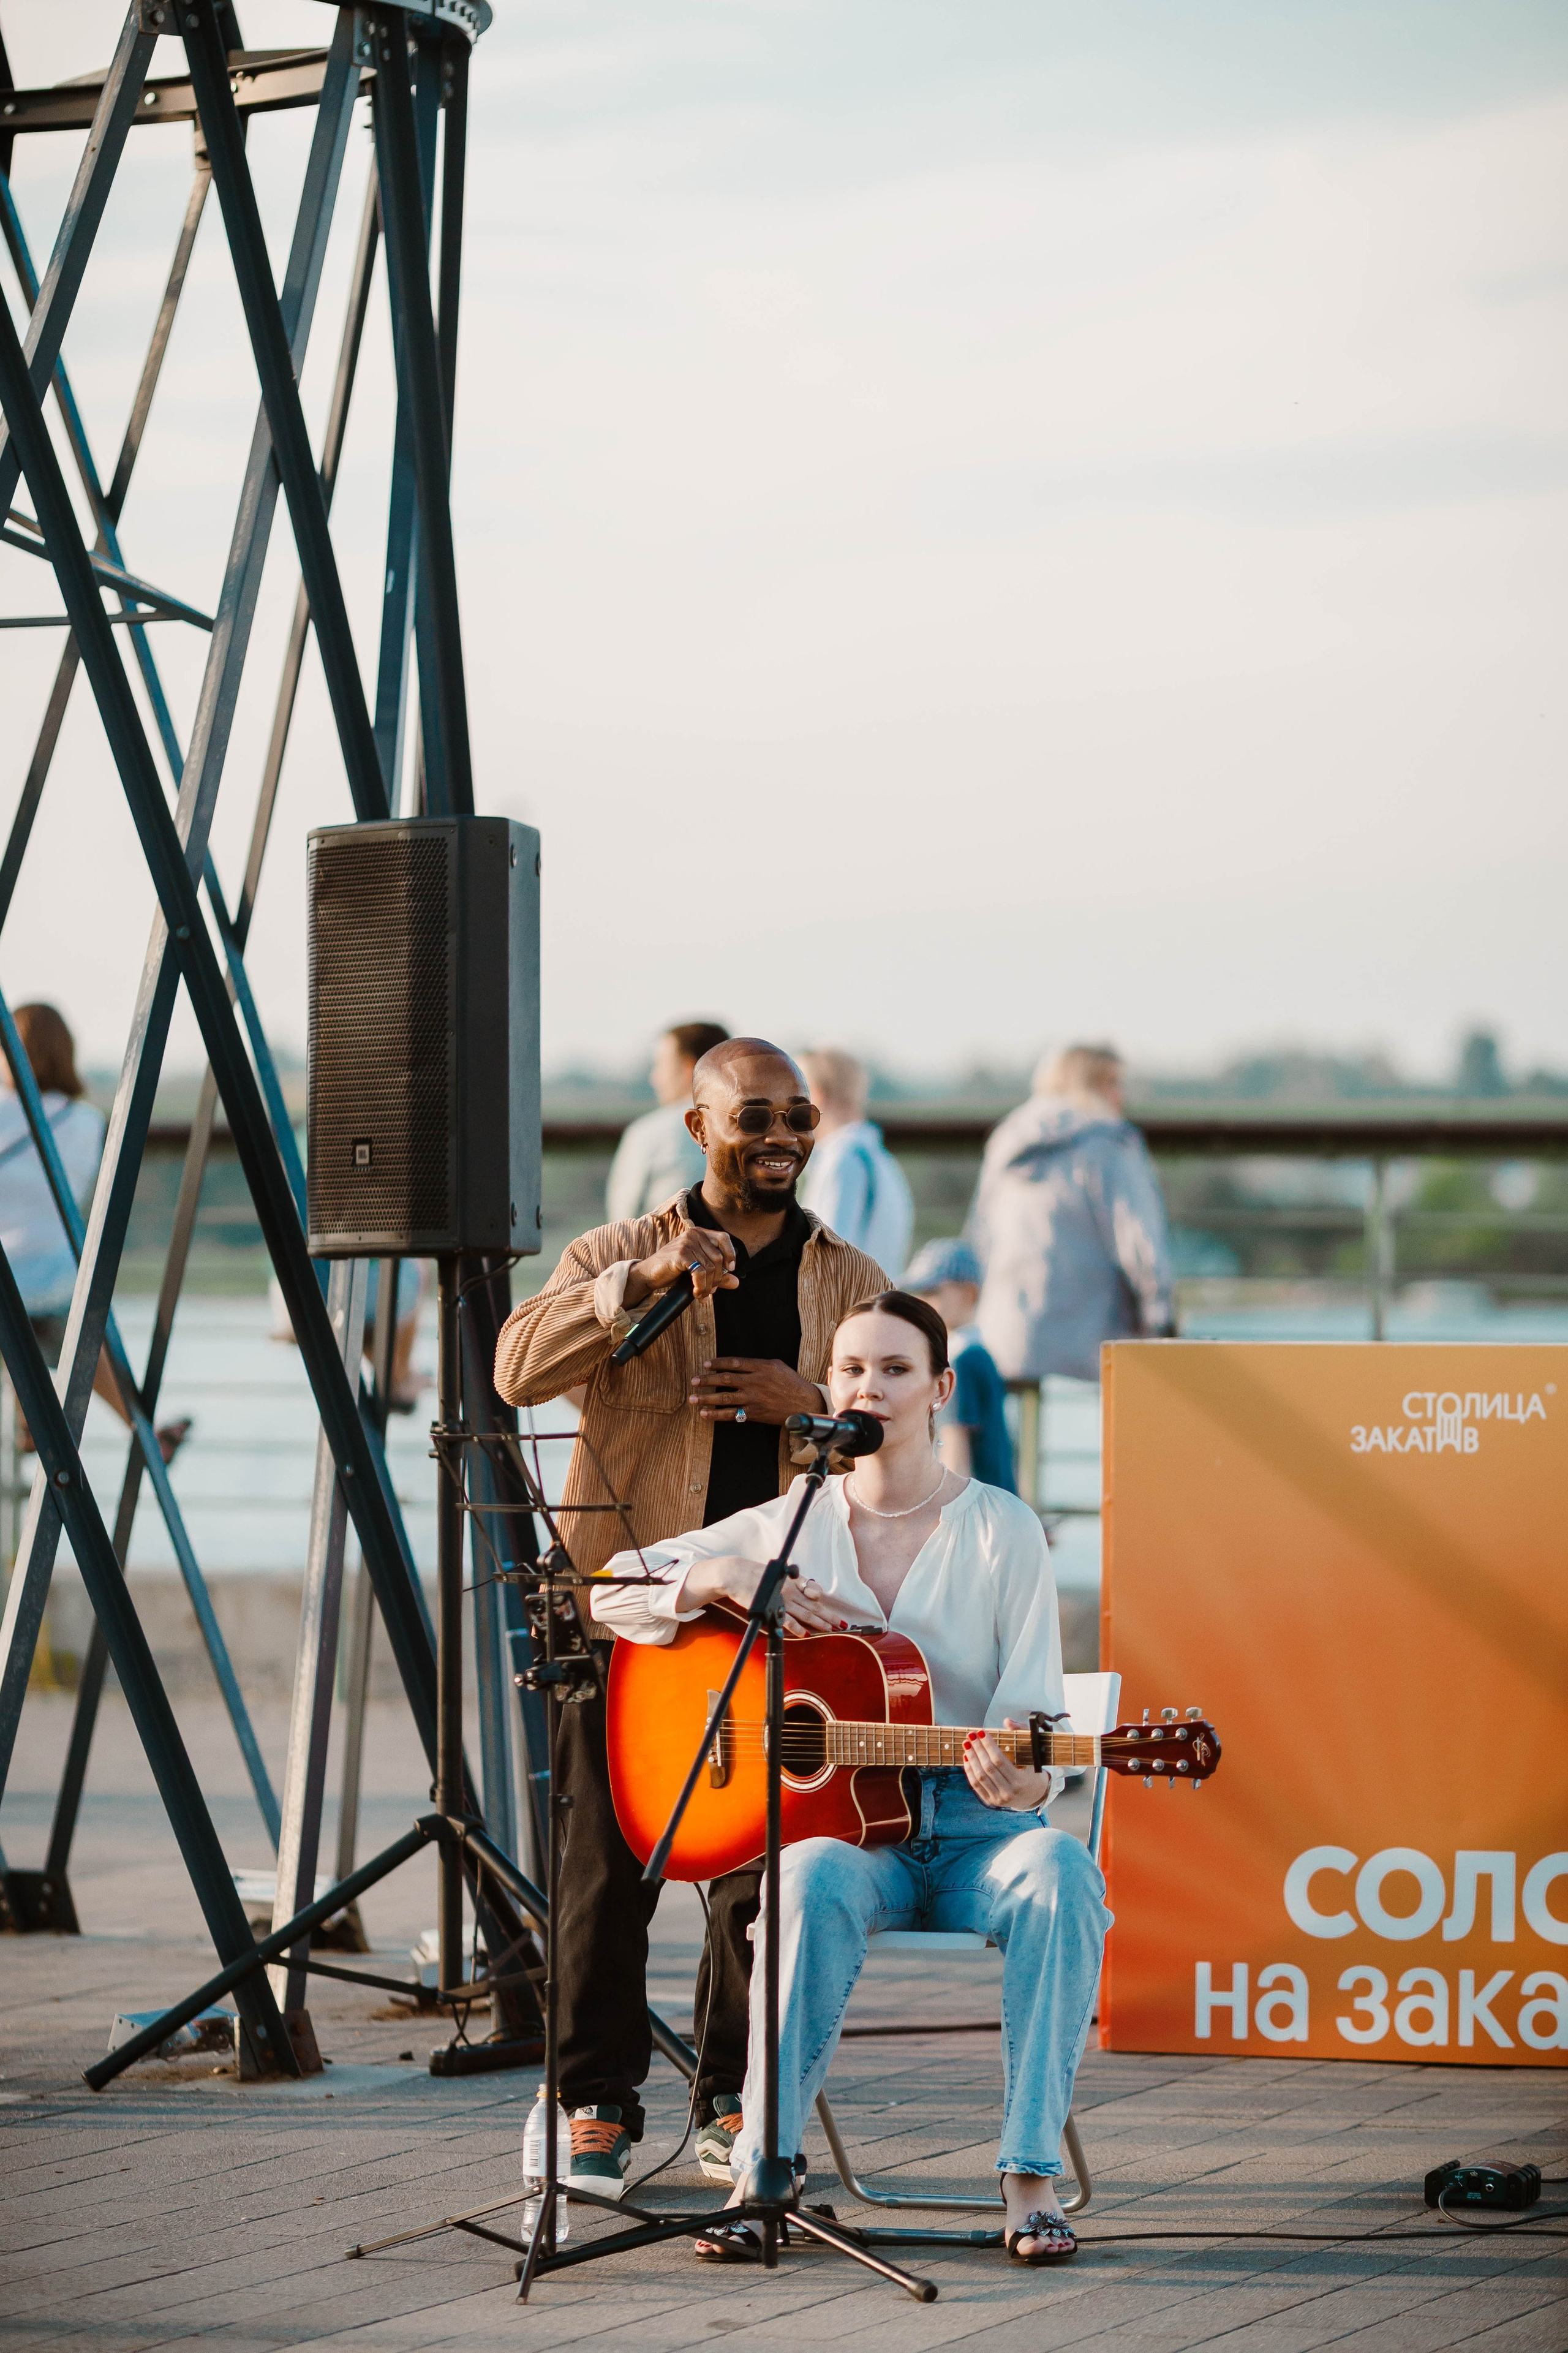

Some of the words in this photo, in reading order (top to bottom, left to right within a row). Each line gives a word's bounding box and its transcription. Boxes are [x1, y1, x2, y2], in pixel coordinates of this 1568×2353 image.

[1401, 1391, 1547, 1424] СТОЛИЦА
[1195, 1962, 1310, 2042] на
[1336, 1965, 1568, 2050] зака
